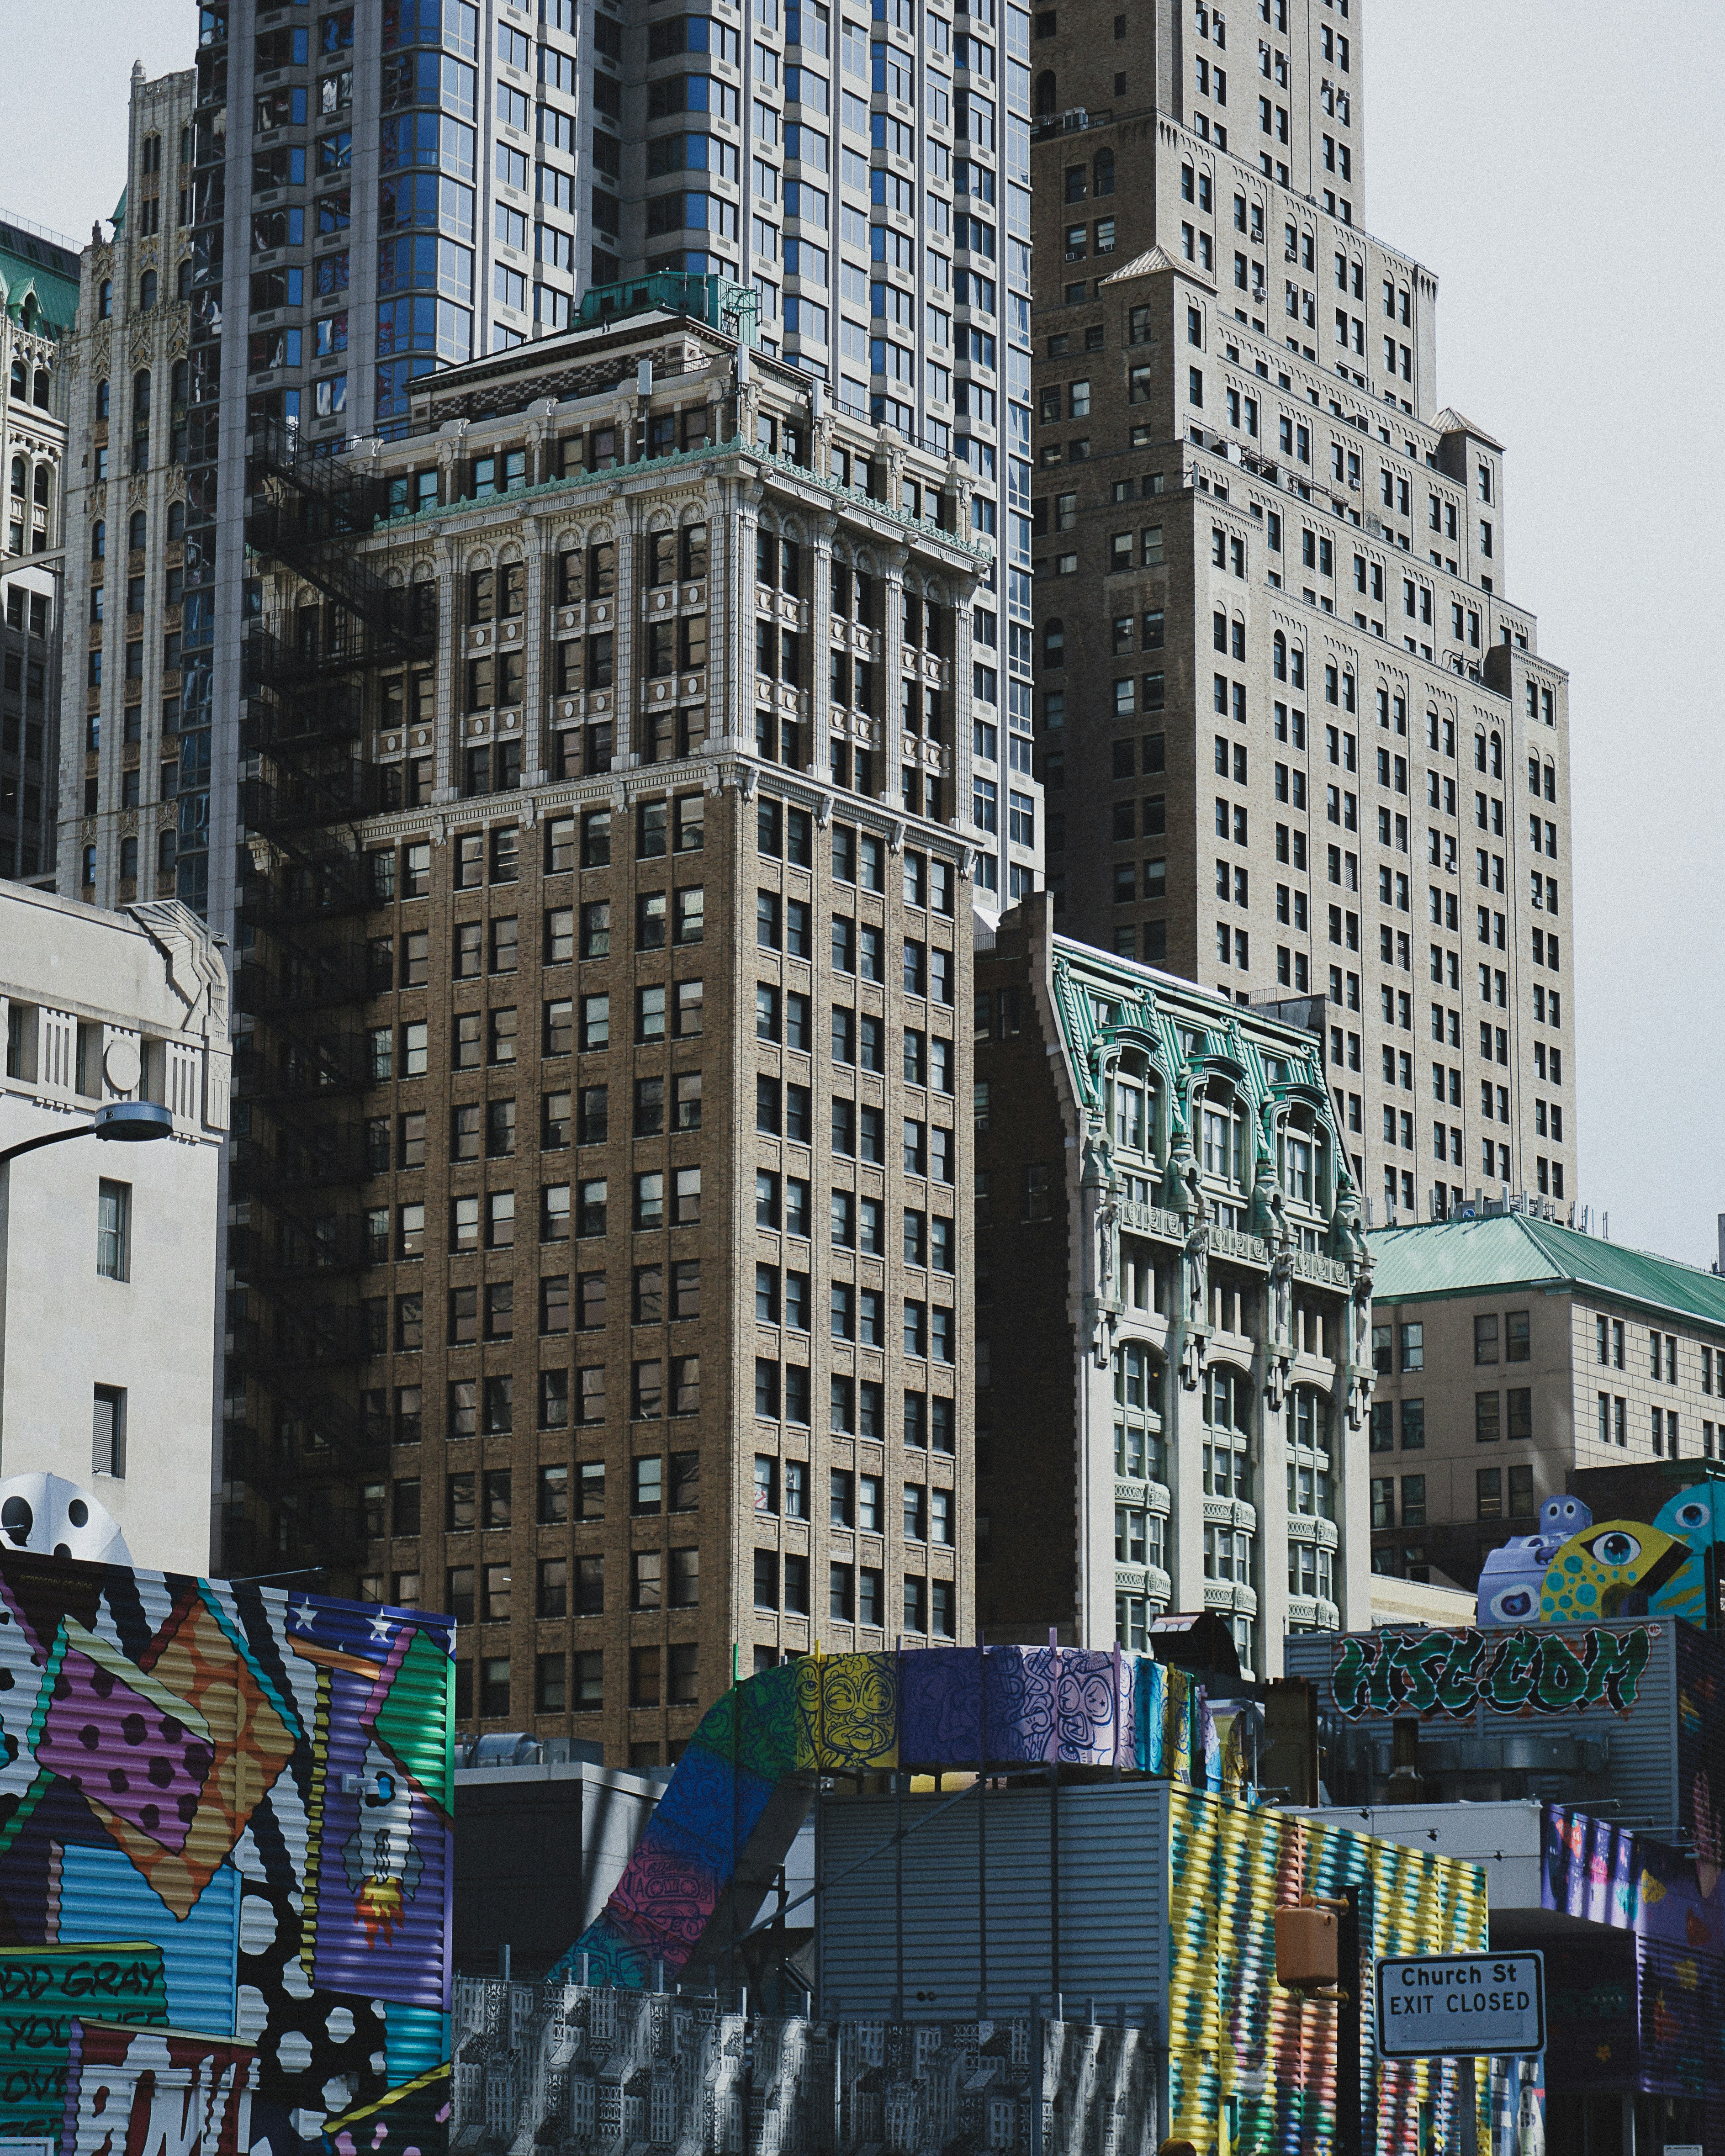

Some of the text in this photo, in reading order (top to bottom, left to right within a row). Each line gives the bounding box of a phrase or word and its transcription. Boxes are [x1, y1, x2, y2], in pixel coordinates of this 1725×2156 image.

[61, 1961, 165, 1997] GRAY
[1402, 1964, 1516, 1986] Church St
[1391, 1992, 1529, 2014] EXIT CLOSED
